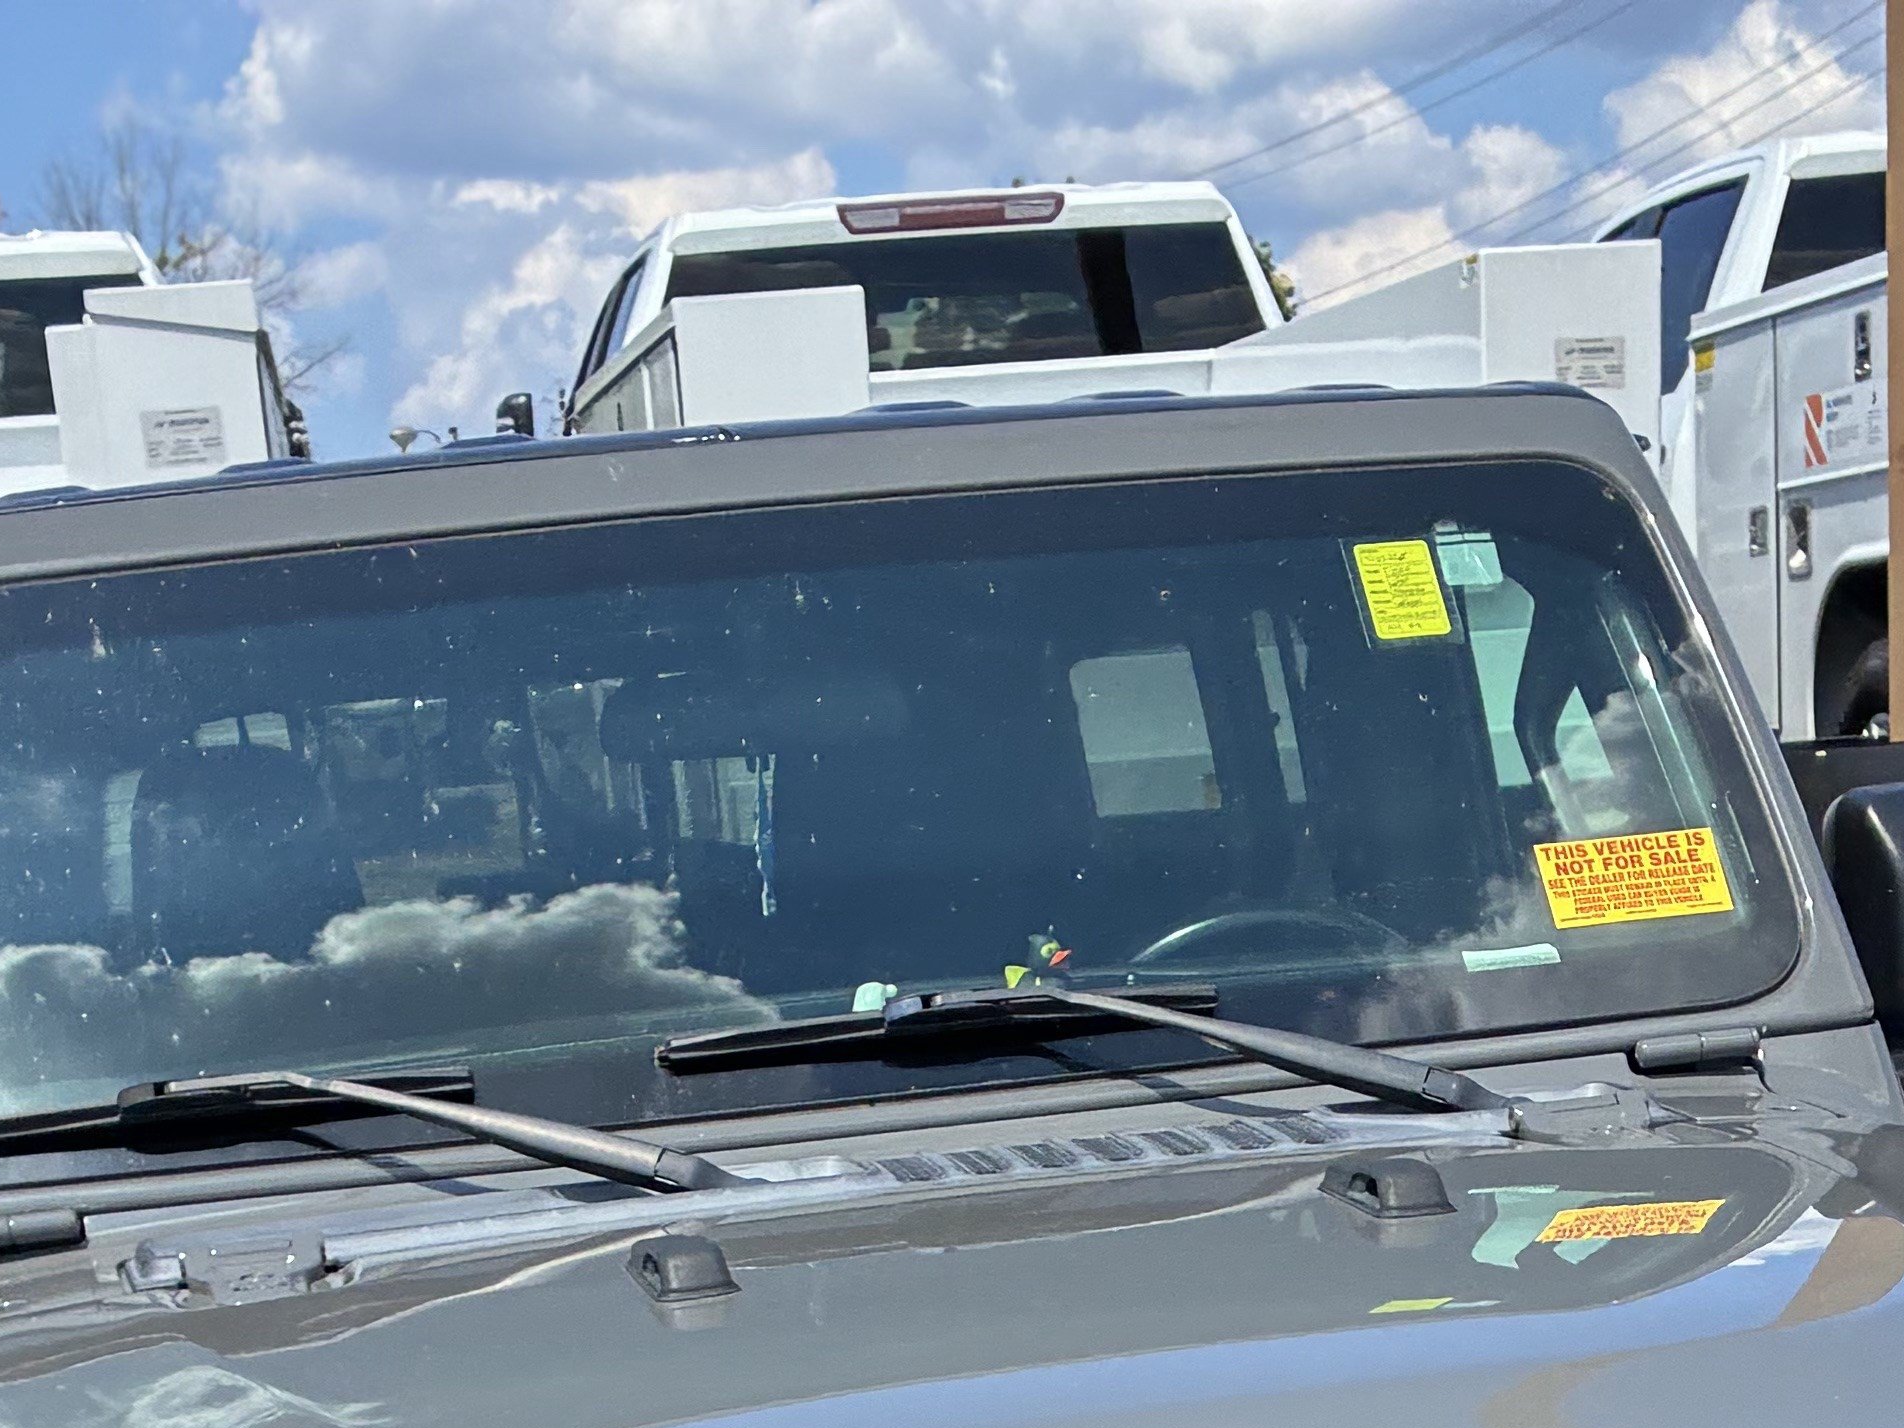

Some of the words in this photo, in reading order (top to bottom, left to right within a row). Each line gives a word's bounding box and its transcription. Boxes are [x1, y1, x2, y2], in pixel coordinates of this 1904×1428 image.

[1539, 843, 1588, 862] THIS
[1592, 833, 1680, 856] VEHICLE
[1684, 831, 1705, 846] IS
[1553, 858, 1597, 876] NOT
[1601, 853, 1644, 871] FOR
[1647, 847, 1701, 866] SALE
